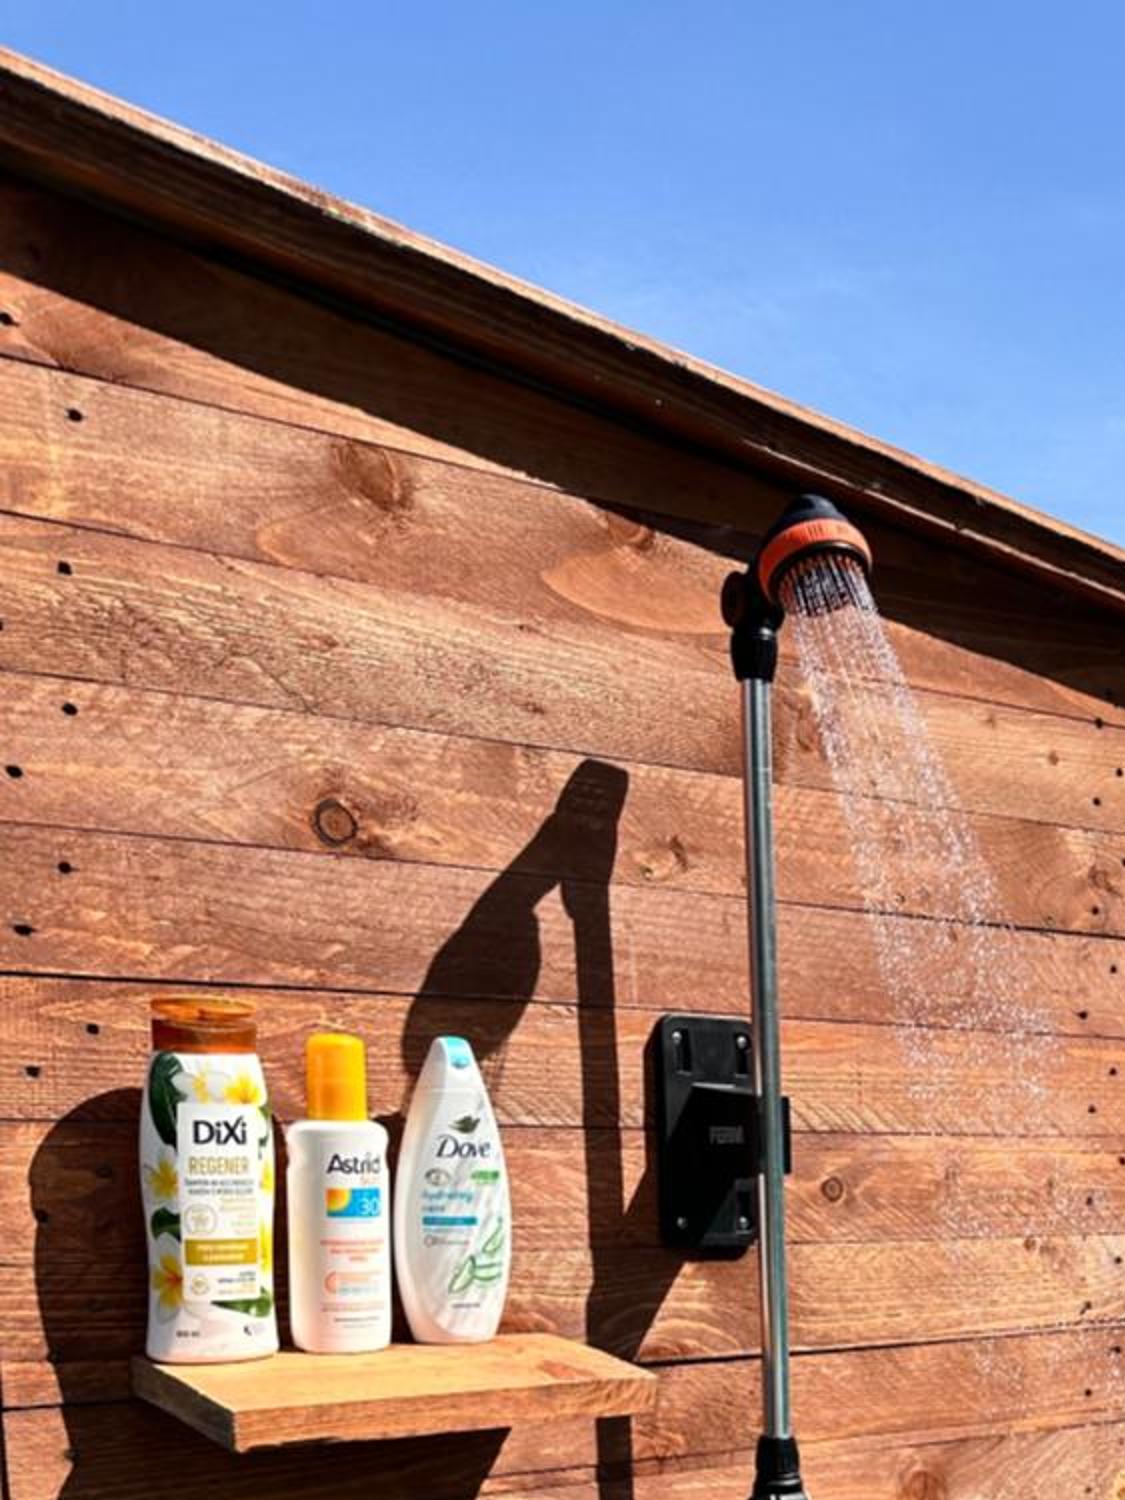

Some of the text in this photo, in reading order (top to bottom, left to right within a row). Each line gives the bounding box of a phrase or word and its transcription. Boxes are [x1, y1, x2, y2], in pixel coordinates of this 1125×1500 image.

[193, 1115, 247, 1145] DiXi
[436, 1134, 491, 1158] Dove
[326, 1152, 381, 1174] Astrid
[360, 1196, 379, 1216] 30
